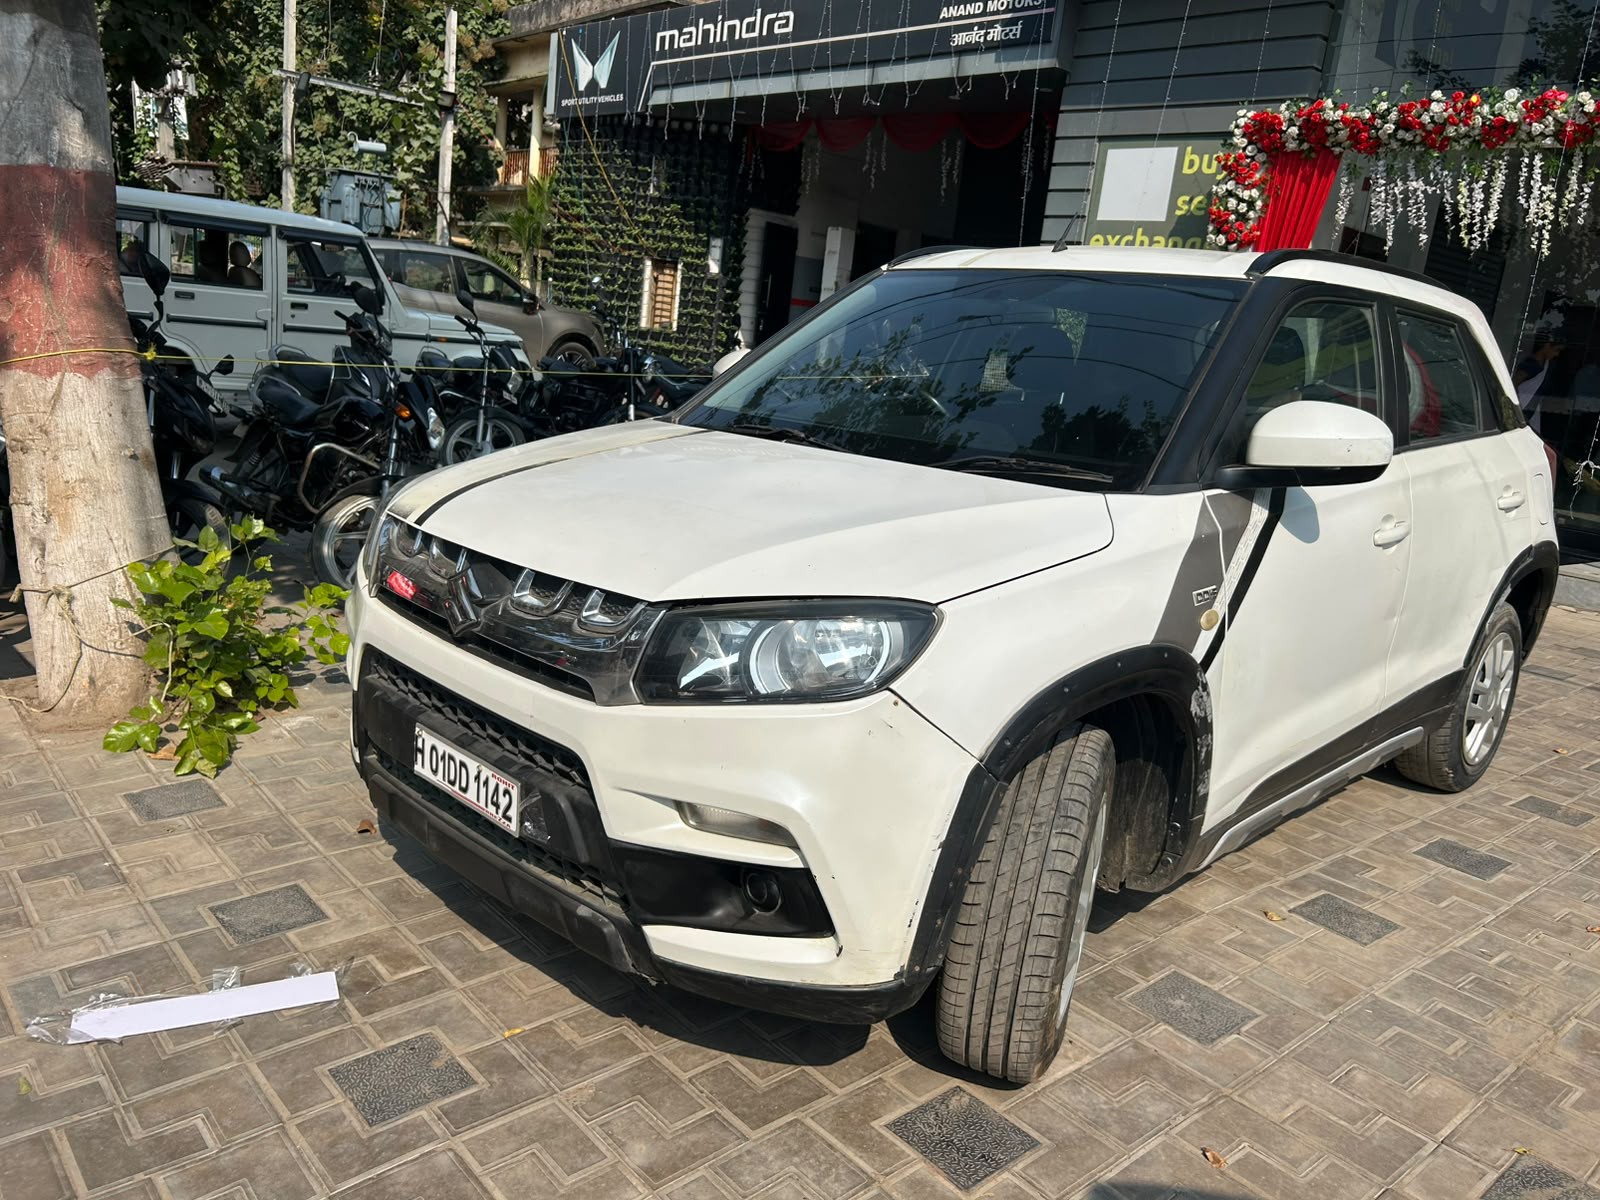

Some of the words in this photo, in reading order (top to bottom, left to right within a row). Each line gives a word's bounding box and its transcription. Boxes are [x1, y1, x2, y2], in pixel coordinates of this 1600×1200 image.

[940, 2, 984, 19] ANAND
[655, 8, 795, 52] mahindra
[950, 25, 986, 46] आनंद
[986, 20, 1023, 41] मोटर्स
[561, 97, 578, 106] SPORT
[578, 96, 598, 105] UTILITY
[598, 93, 624, 103] VEHICLES
[1175, 195, 1208, 216] se
[1089, 228, 1210, 248] exchan
[429, 743, 470, 794] 01DD
[474, 770, 513, 824] 1142
